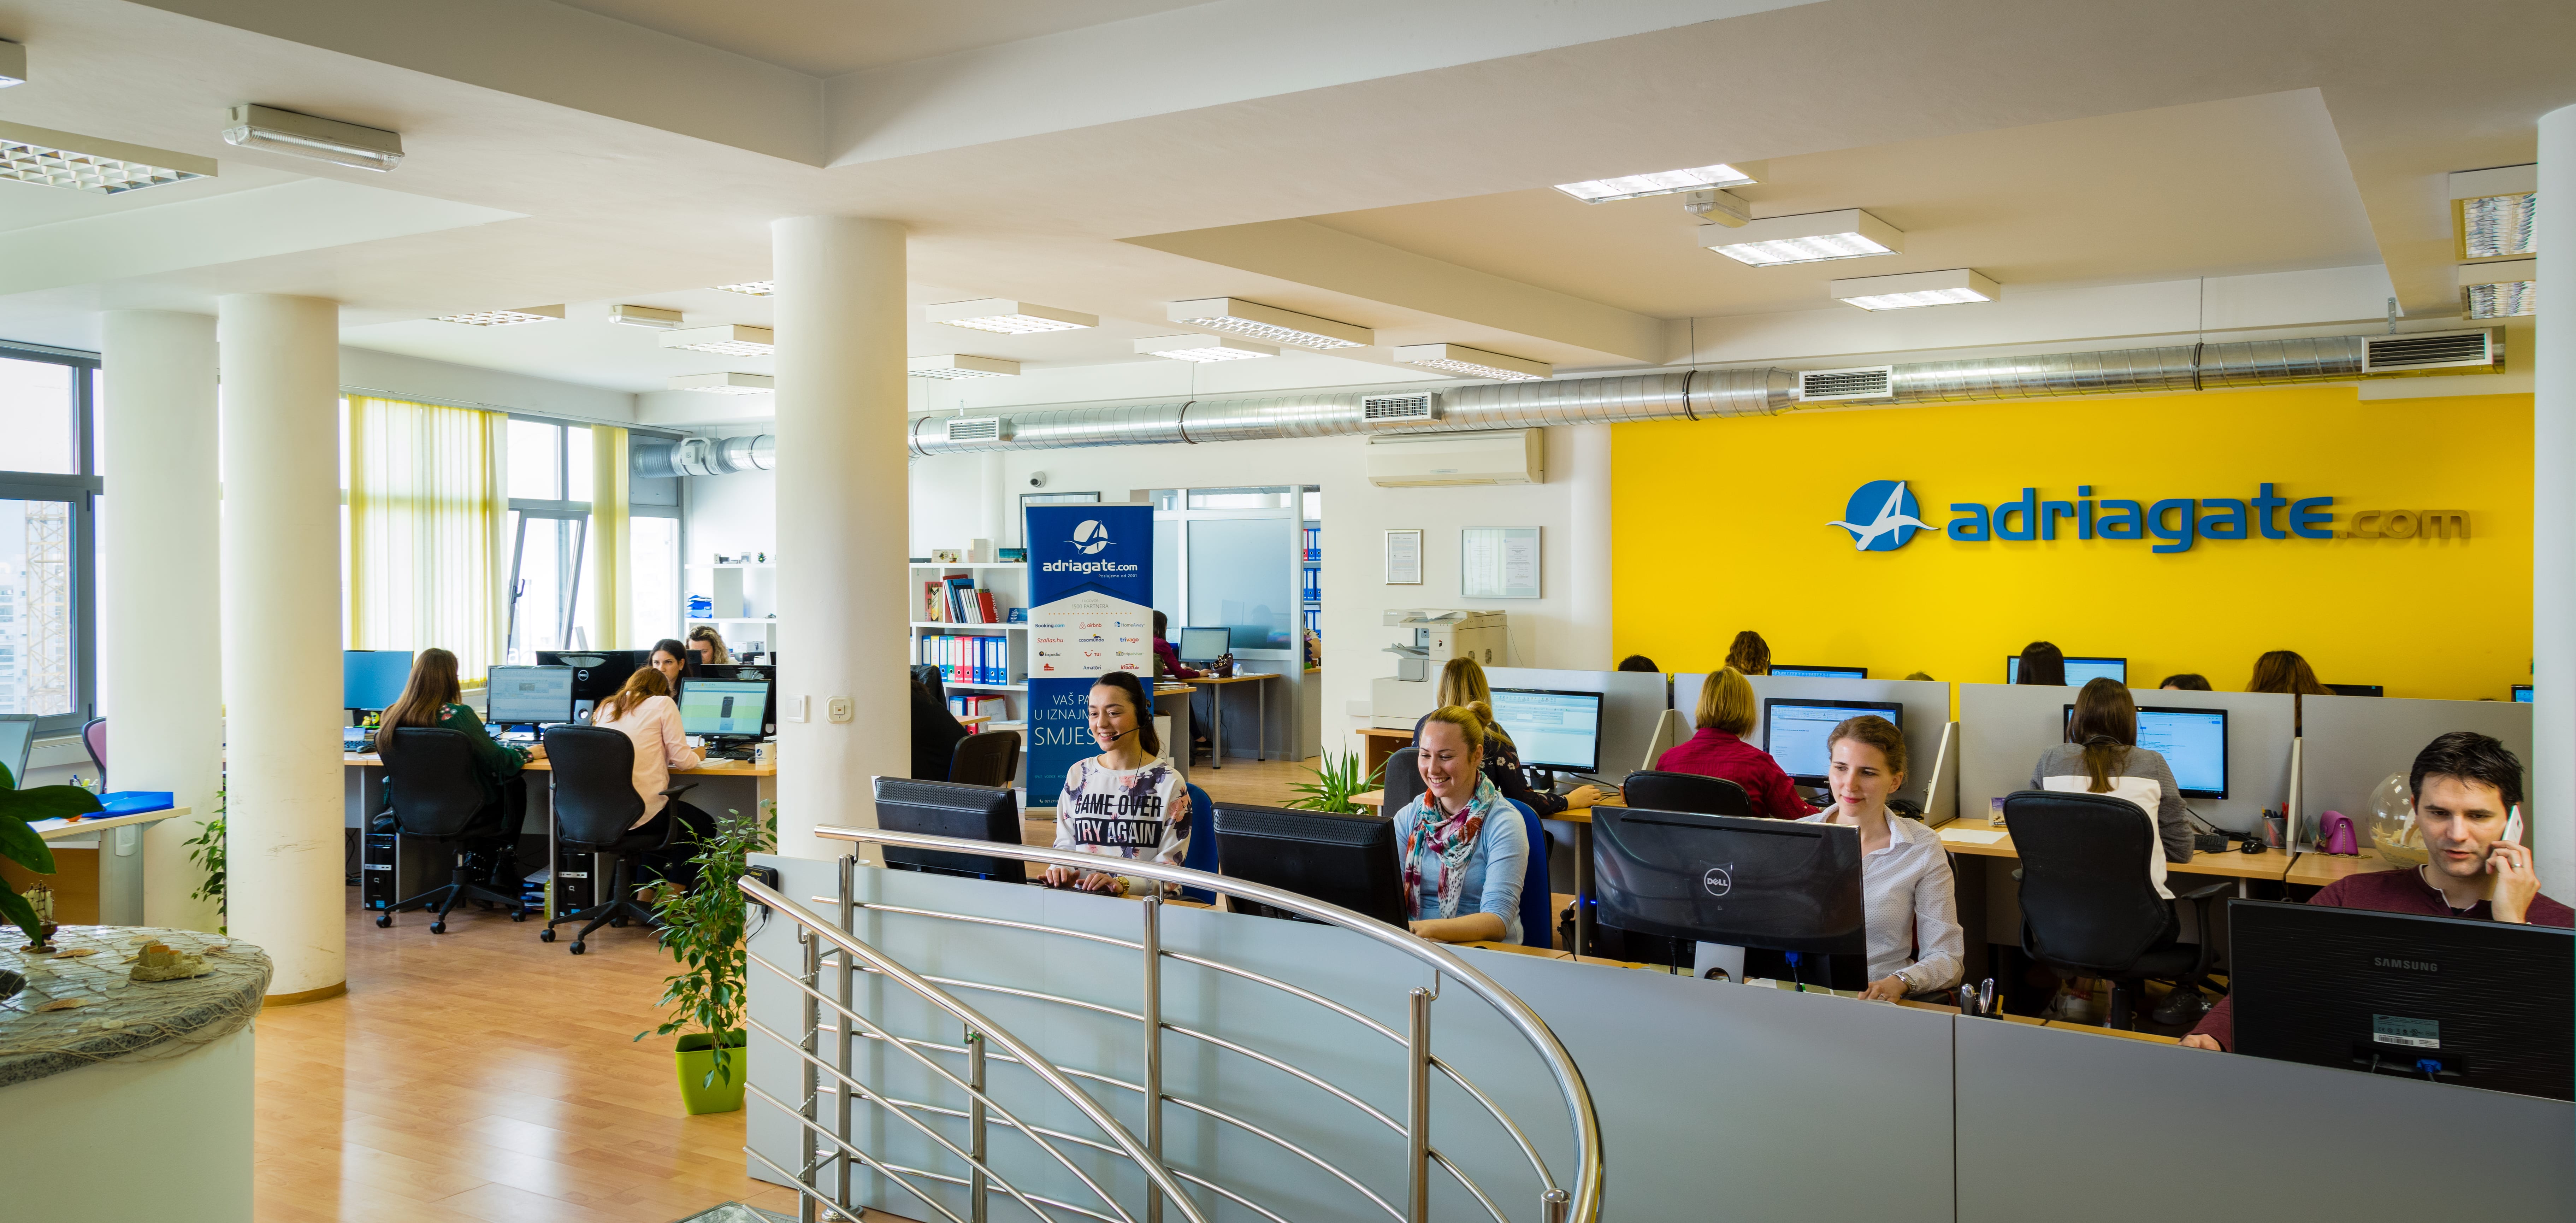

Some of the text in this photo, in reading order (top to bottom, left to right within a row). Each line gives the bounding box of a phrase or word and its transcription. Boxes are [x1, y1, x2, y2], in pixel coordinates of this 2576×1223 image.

[1947, 483, 2471, 554] adriagate.com
[1043, 559, 1138, 574] adriagate.com
[1053, 692, 1089, 705] VAŠ PA
[1035, 709, 1089, 720] U IZNAJM
[1035, 727, 1097, 745] SMJES
[1075, 793, 1162, 817] GAME OVER
[1076, 819, 1156, 844] TRY AGAIN
[1707, 878, 1728, 886] DELL
[2374, 957, 2438, 972] SAMSUNG
